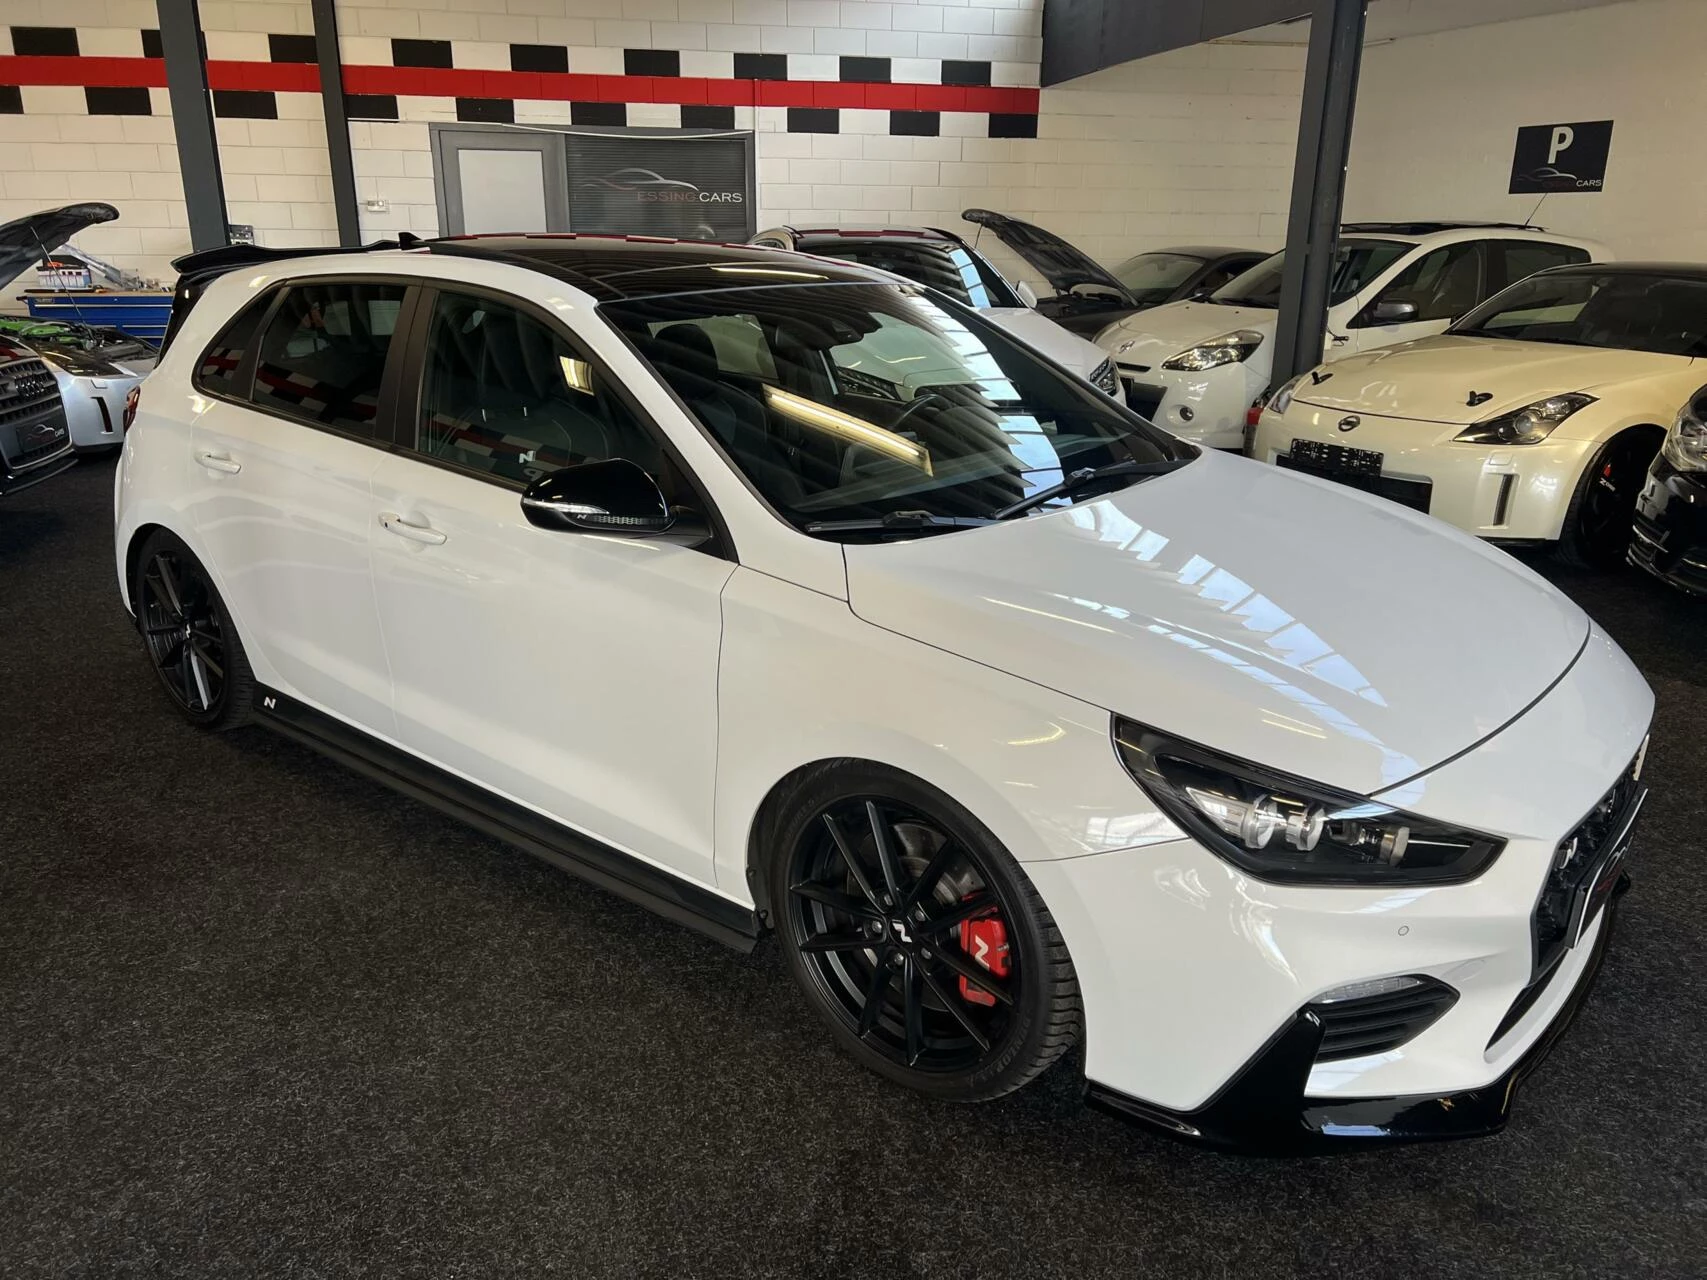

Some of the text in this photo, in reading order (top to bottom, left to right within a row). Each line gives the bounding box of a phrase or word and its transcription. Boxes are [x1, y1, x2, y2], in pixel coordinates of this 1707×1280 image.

[1547, 126, 1574, 164] P
[699, 192, 743, 203] CARS
[264, 696, 277, 709] N
